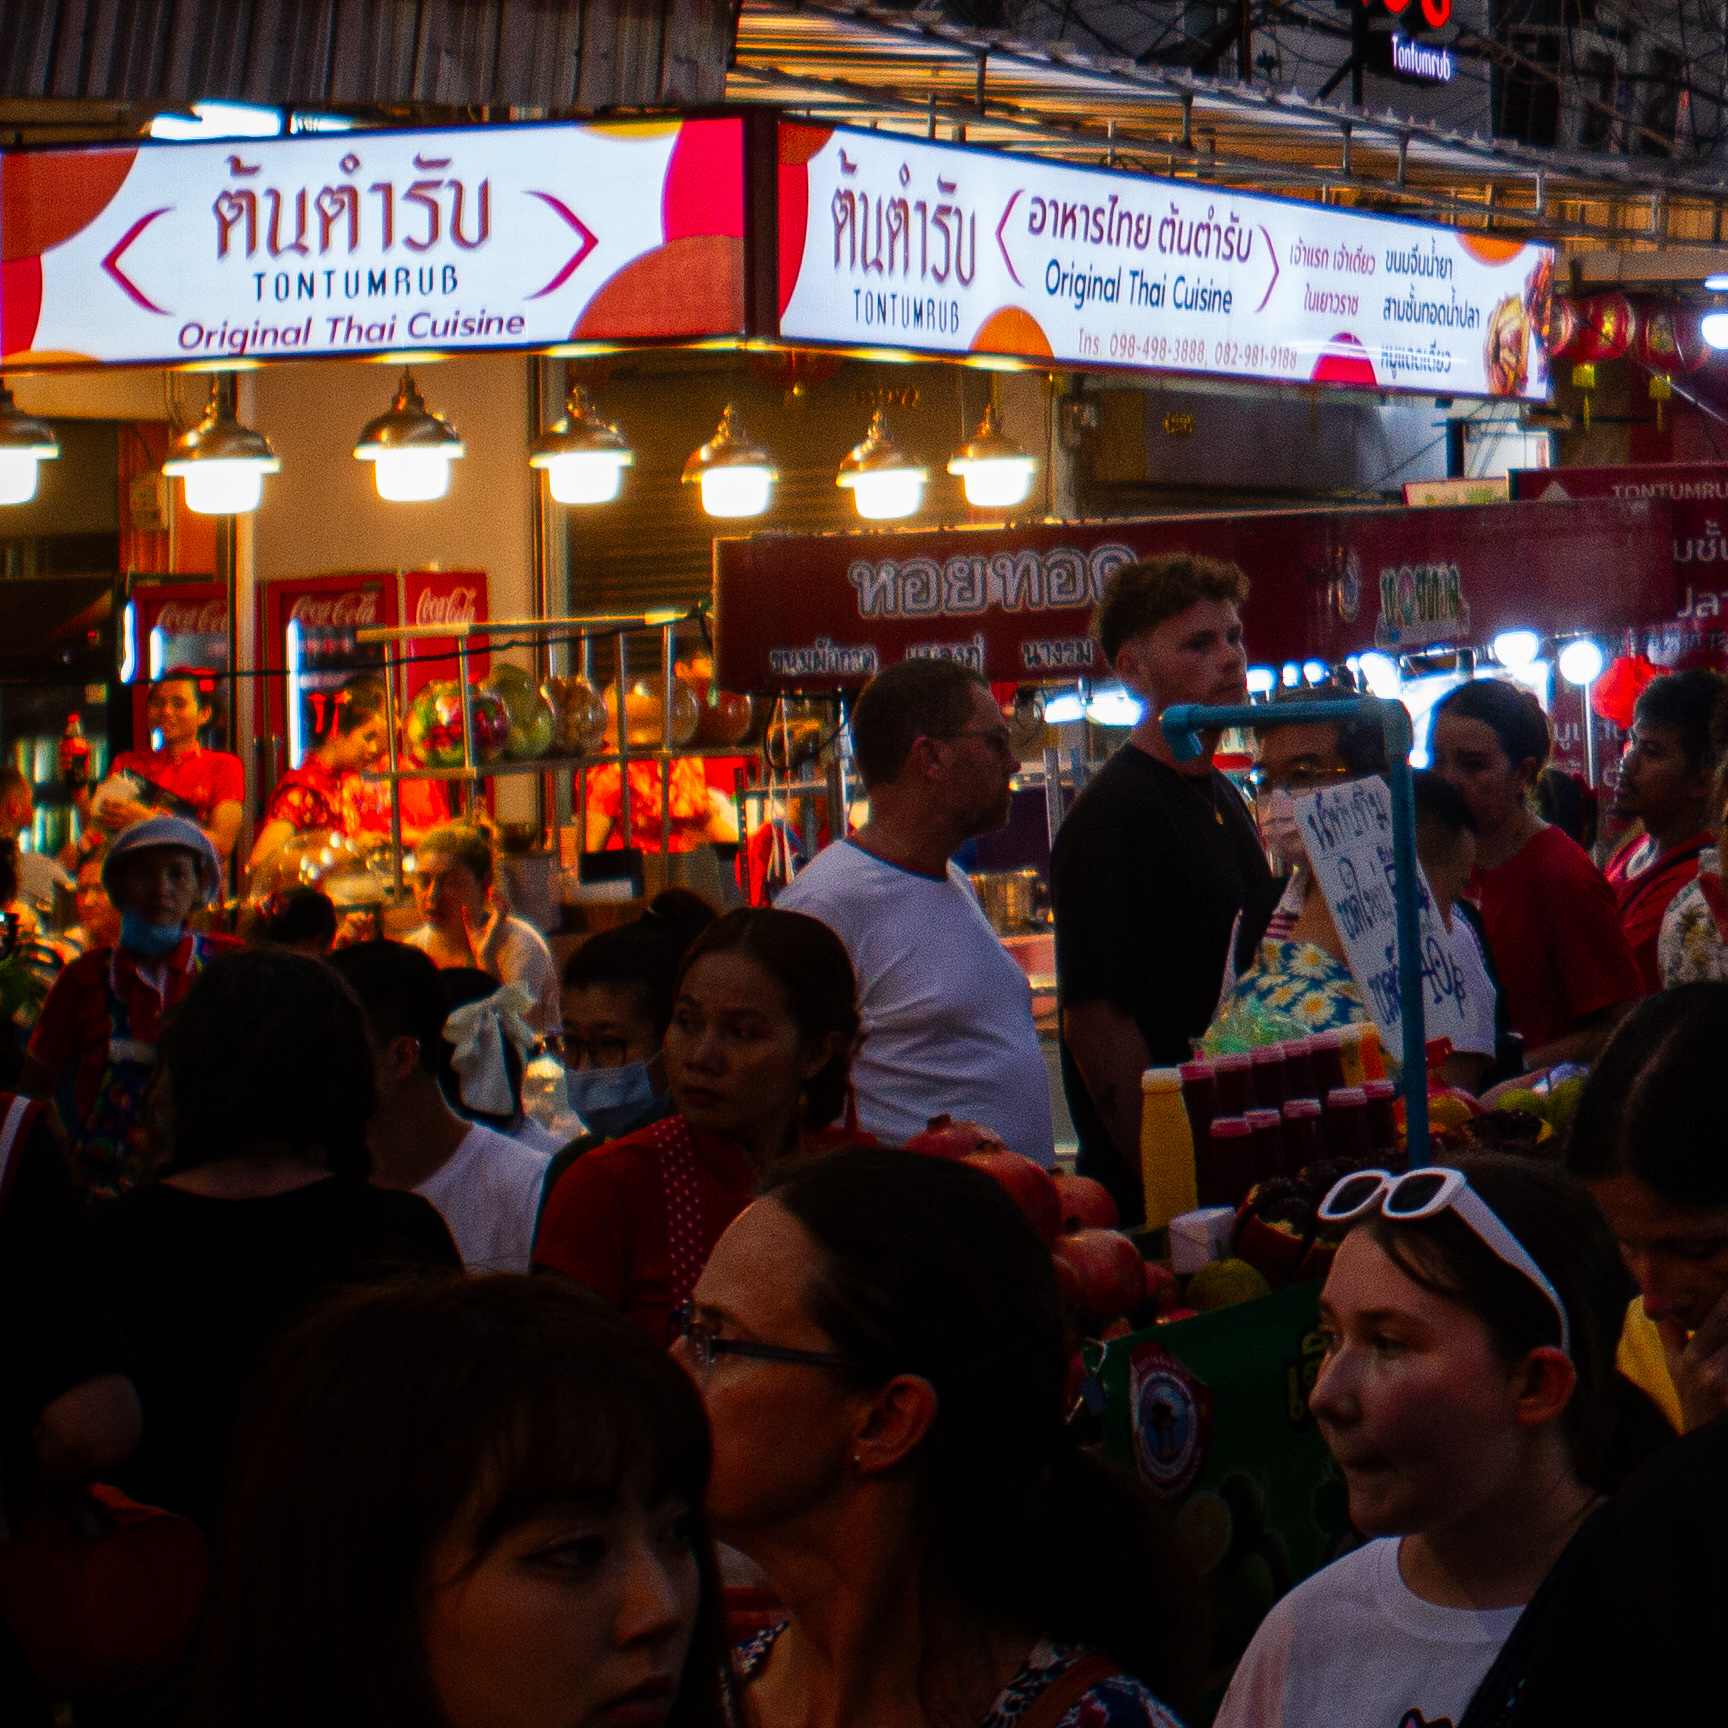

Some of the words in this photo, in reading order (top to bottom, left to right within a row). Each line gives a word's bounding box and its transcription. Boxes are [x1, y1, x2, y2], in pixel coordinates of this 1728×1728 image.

[1391, 34, 1452, 83] Tontumrub
[211, 153, 492, 261] ต้นตำรับ
[831, 147, 977, 287] ต้นตำรับ
[1027, 193, 1151, 251] อาหารไทย
[1157, 202, 1254, 265] ต้นตำรับ
[1290, 237, 1329, 270] เจ้าแรก
[1386, 236, 1453, 281] ขนมจีนน้ำยา
[253, 264, 460, 303] TONTUMRUB
[1045, 258, 1121, 311] Original
[1129, 269, 1166, 308] Thai
[1172, 275, 1233, 314] Cuisine
[1304, 281, 1359, 318] ในเยาวราช
[1383, 283, 1481, 330] สามชั้นทอดน้ำปลา
[177, 315, 313, 356] Original
[325, 311, 397, 345] Thai
[406, 308, 526, 341] Cuisine
[854, 288, 960, 334] TONTUMRUB
